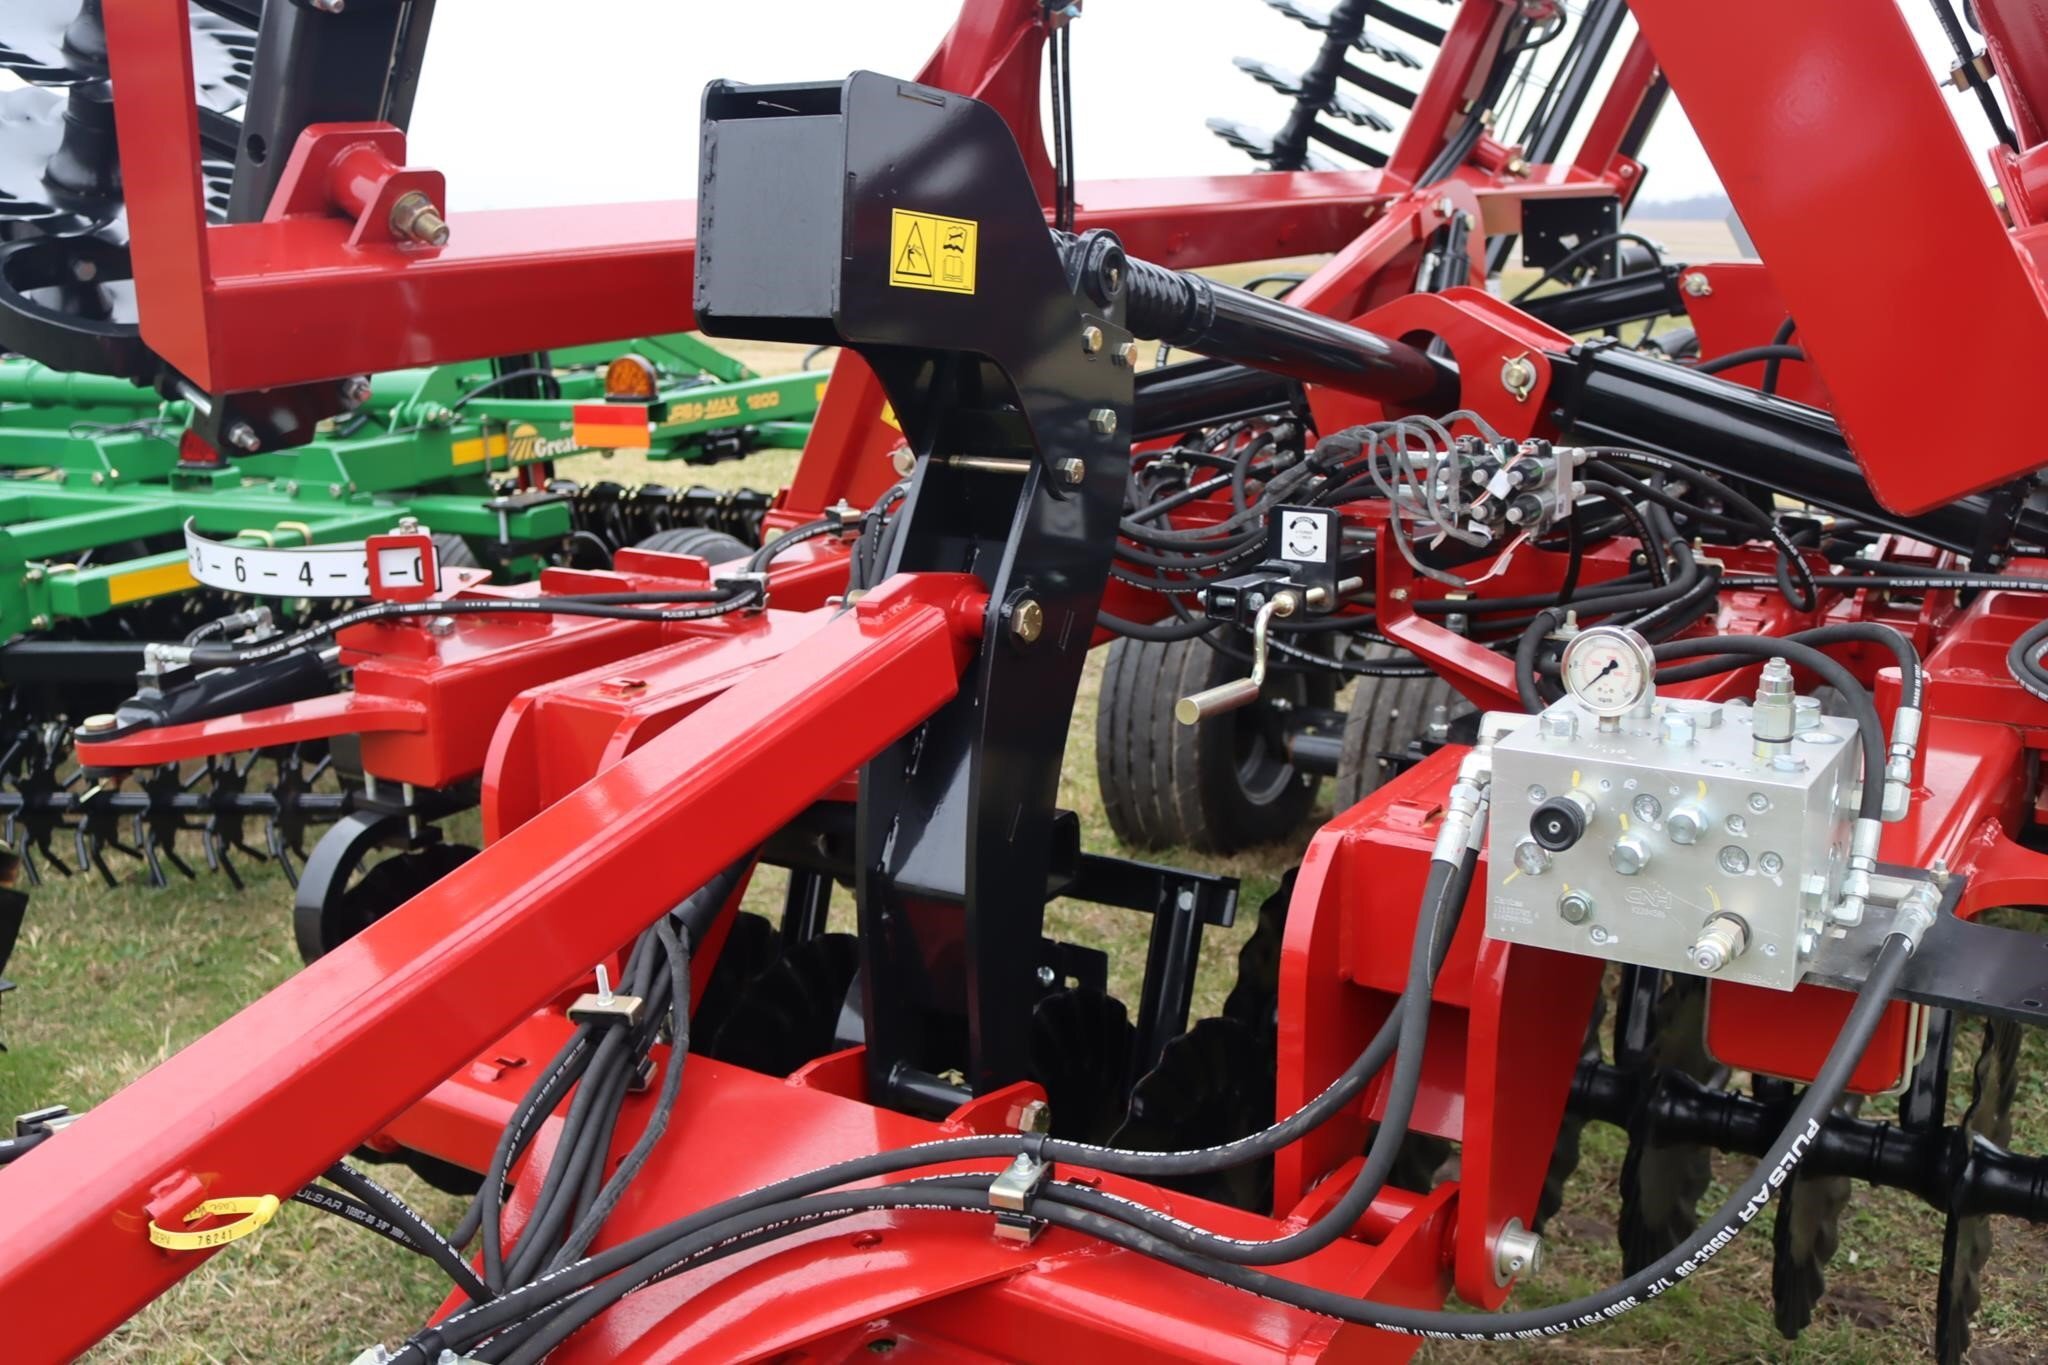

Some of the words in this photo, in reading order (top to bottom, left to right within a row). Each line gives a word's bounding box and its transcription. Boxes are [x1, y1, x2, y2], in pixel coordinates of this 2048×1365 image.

[234, 556, 246, 583] 6
[298, 561, 314, 587] 4
[1738, 1118, 1820, 1223] PULSAR
[296, 1189, 342, 1209] ULSAR
[1580, 1310, 1604, 1327] PSI
[1603, 1294, 1641, 1319] 3000
